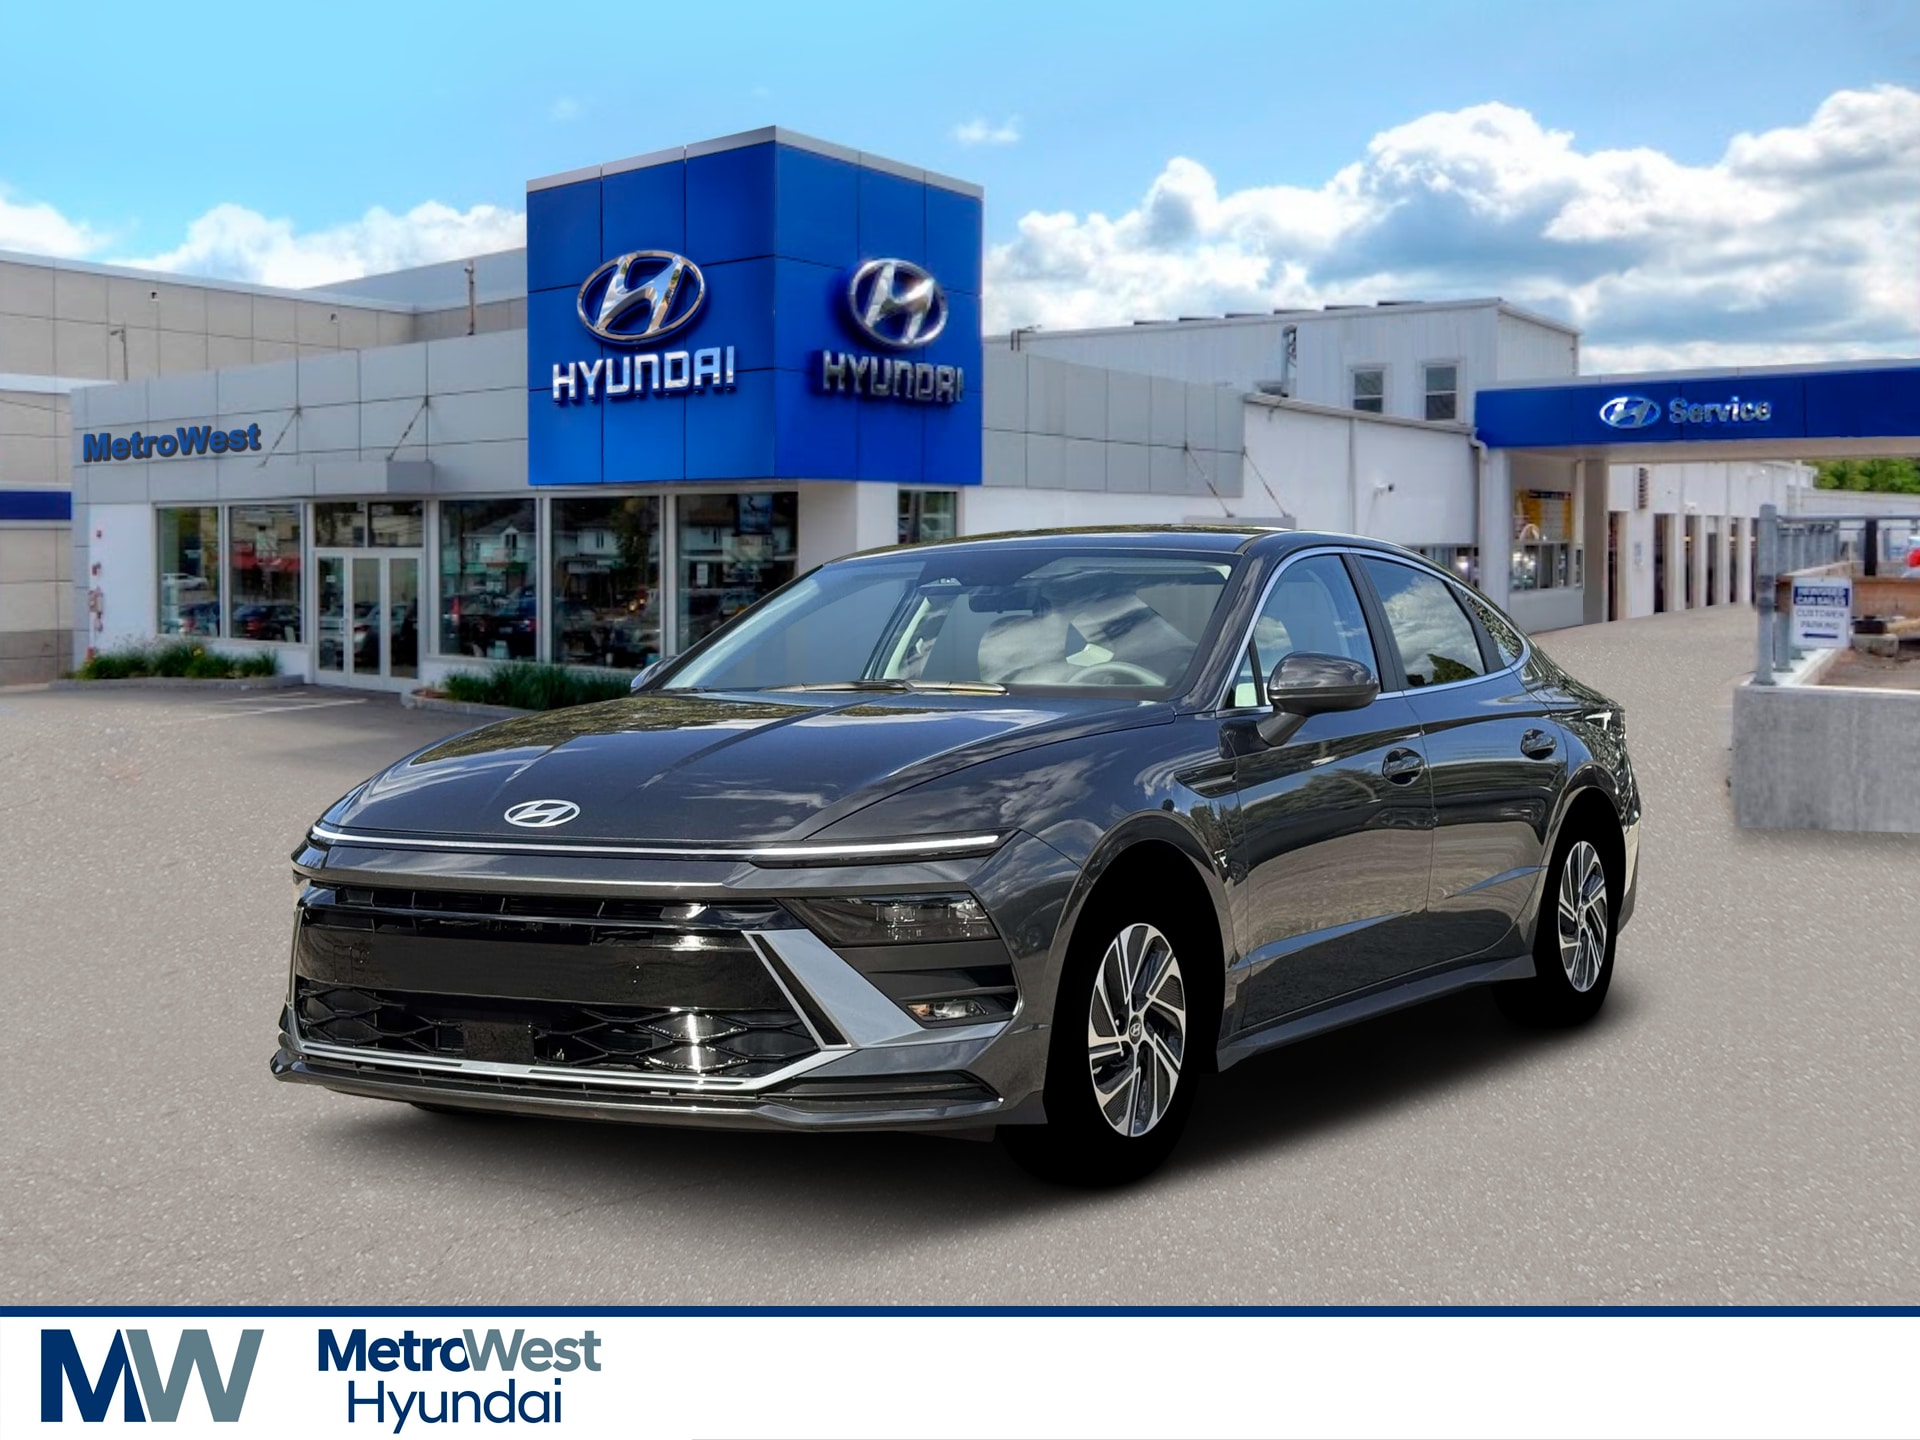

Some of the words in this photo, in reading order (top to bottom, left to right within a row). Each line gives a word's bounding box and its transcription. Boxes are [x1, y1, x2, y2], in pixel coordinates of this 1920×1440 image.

[552, 346, 735, 401] HYUNDAI
[822, 350, 964, 402] HYUNDAI
[1669, 396, 1771, 424] Service
[83, 423, 261, 463] MetroWest
[1800, 621, 1839, 630] PARKING
